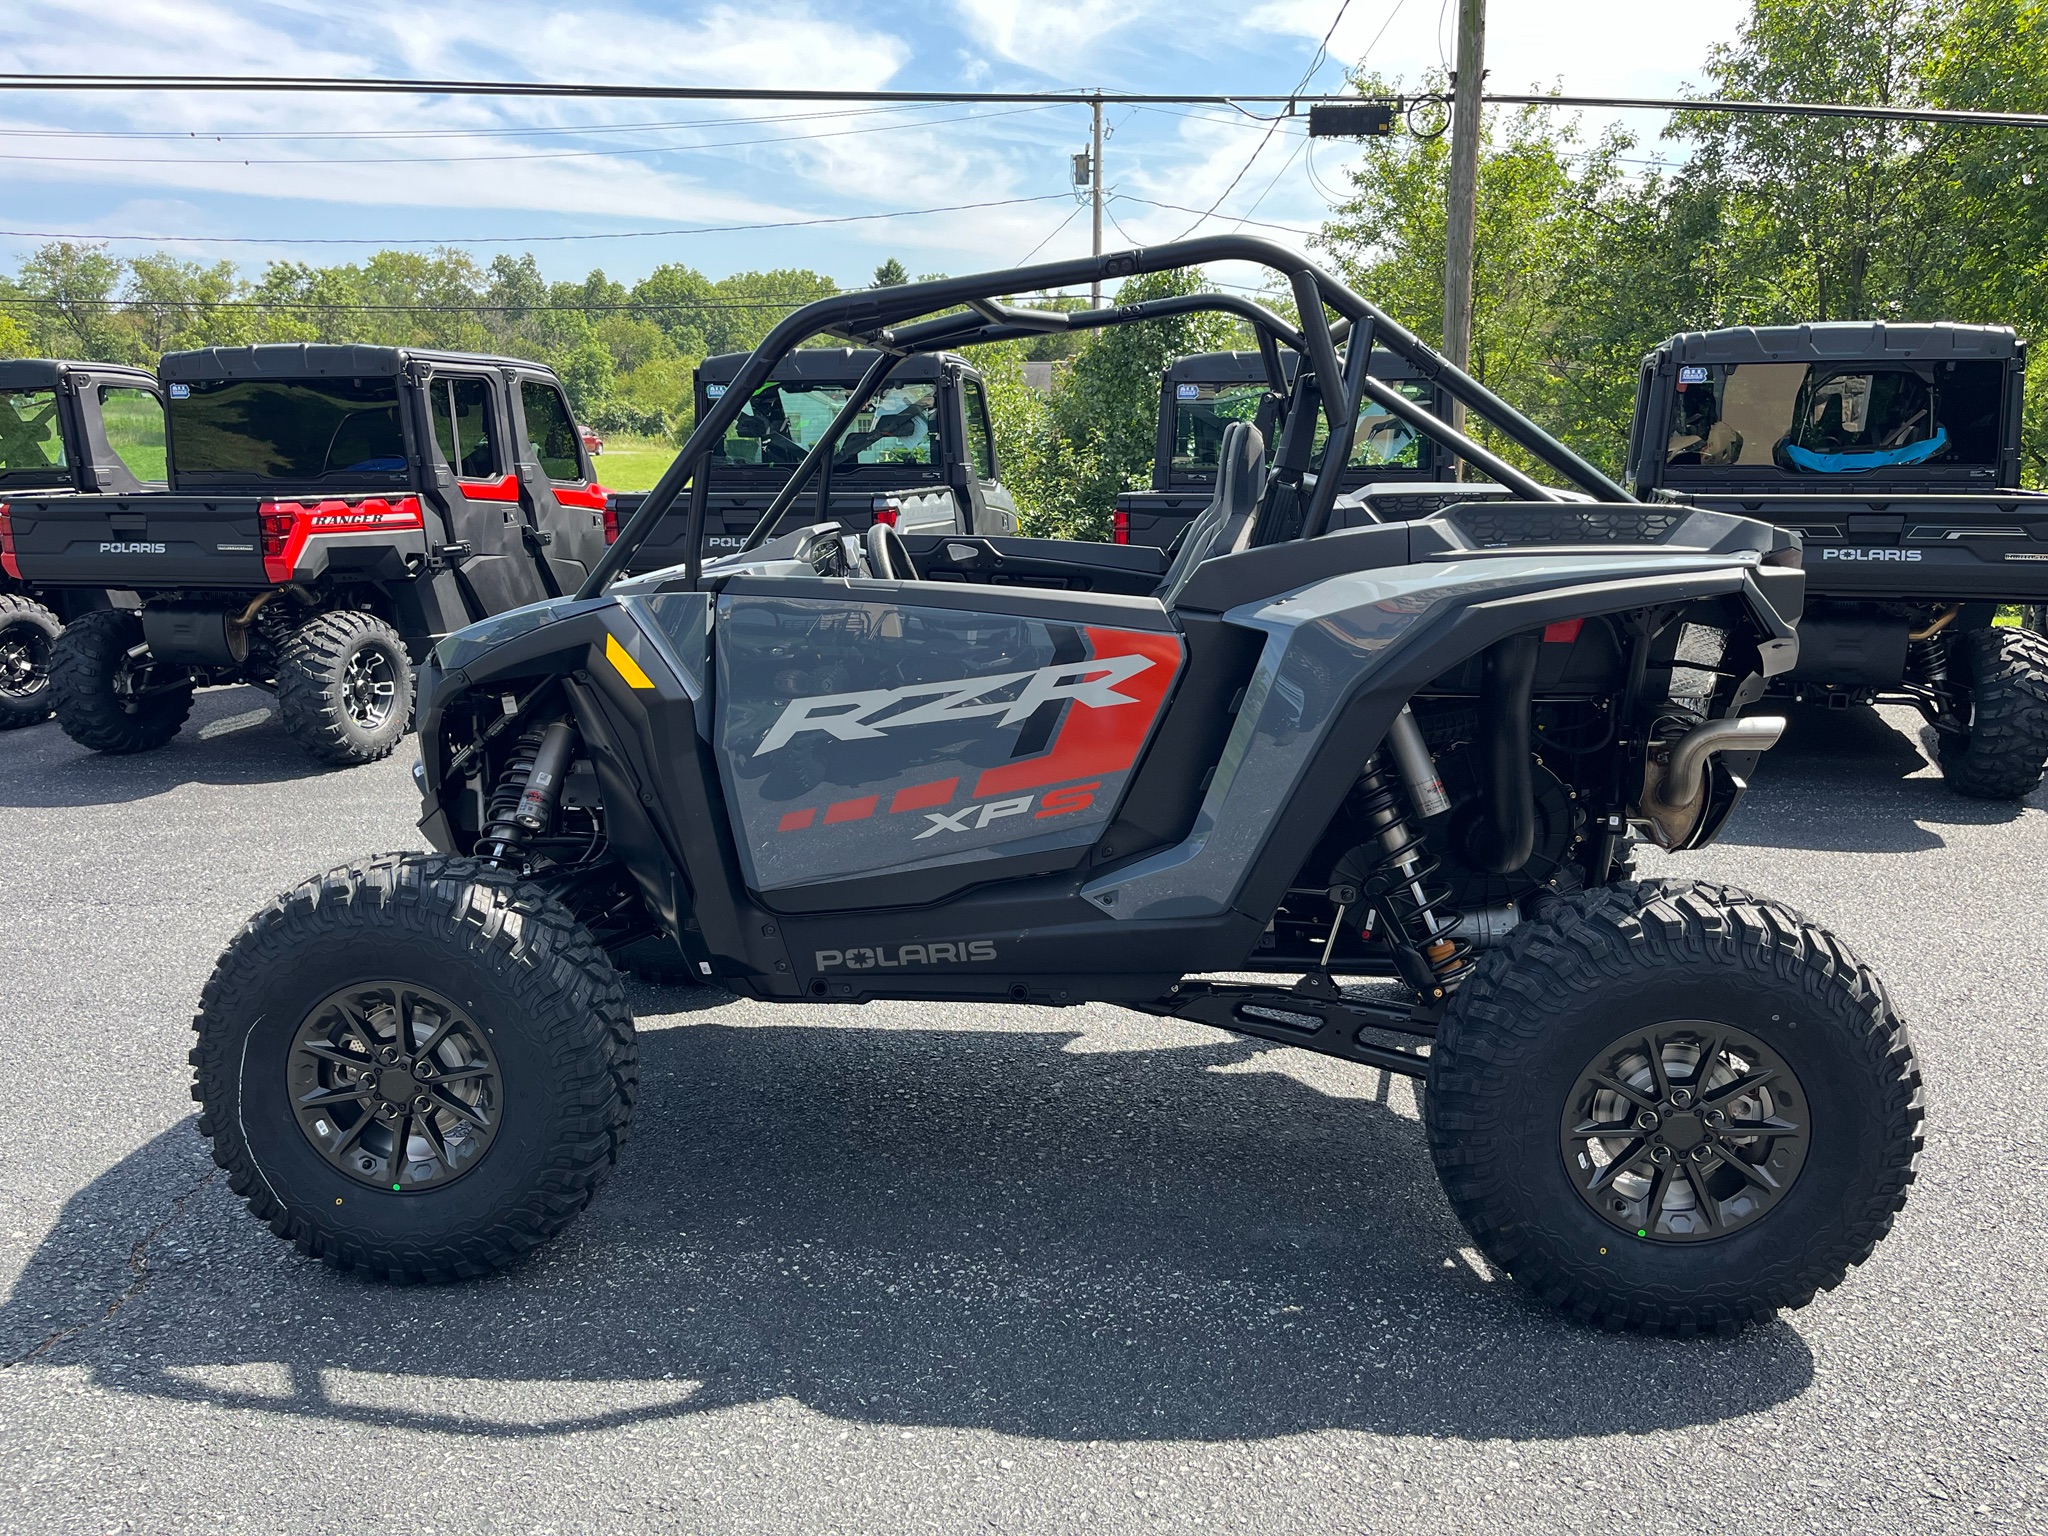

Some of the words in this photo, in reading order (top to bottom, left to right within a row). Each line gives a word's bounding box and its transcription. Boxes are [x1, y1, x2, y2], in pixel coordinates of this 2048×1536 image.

[315, 514, 384, 525] RANGER
[100, 543, 166, 554] POLARIS
[1823, 549, 1922, 562] POLARIS
[752, 653, 1157, 758] RZR
[815, 940, 997, 971] POLARIS
